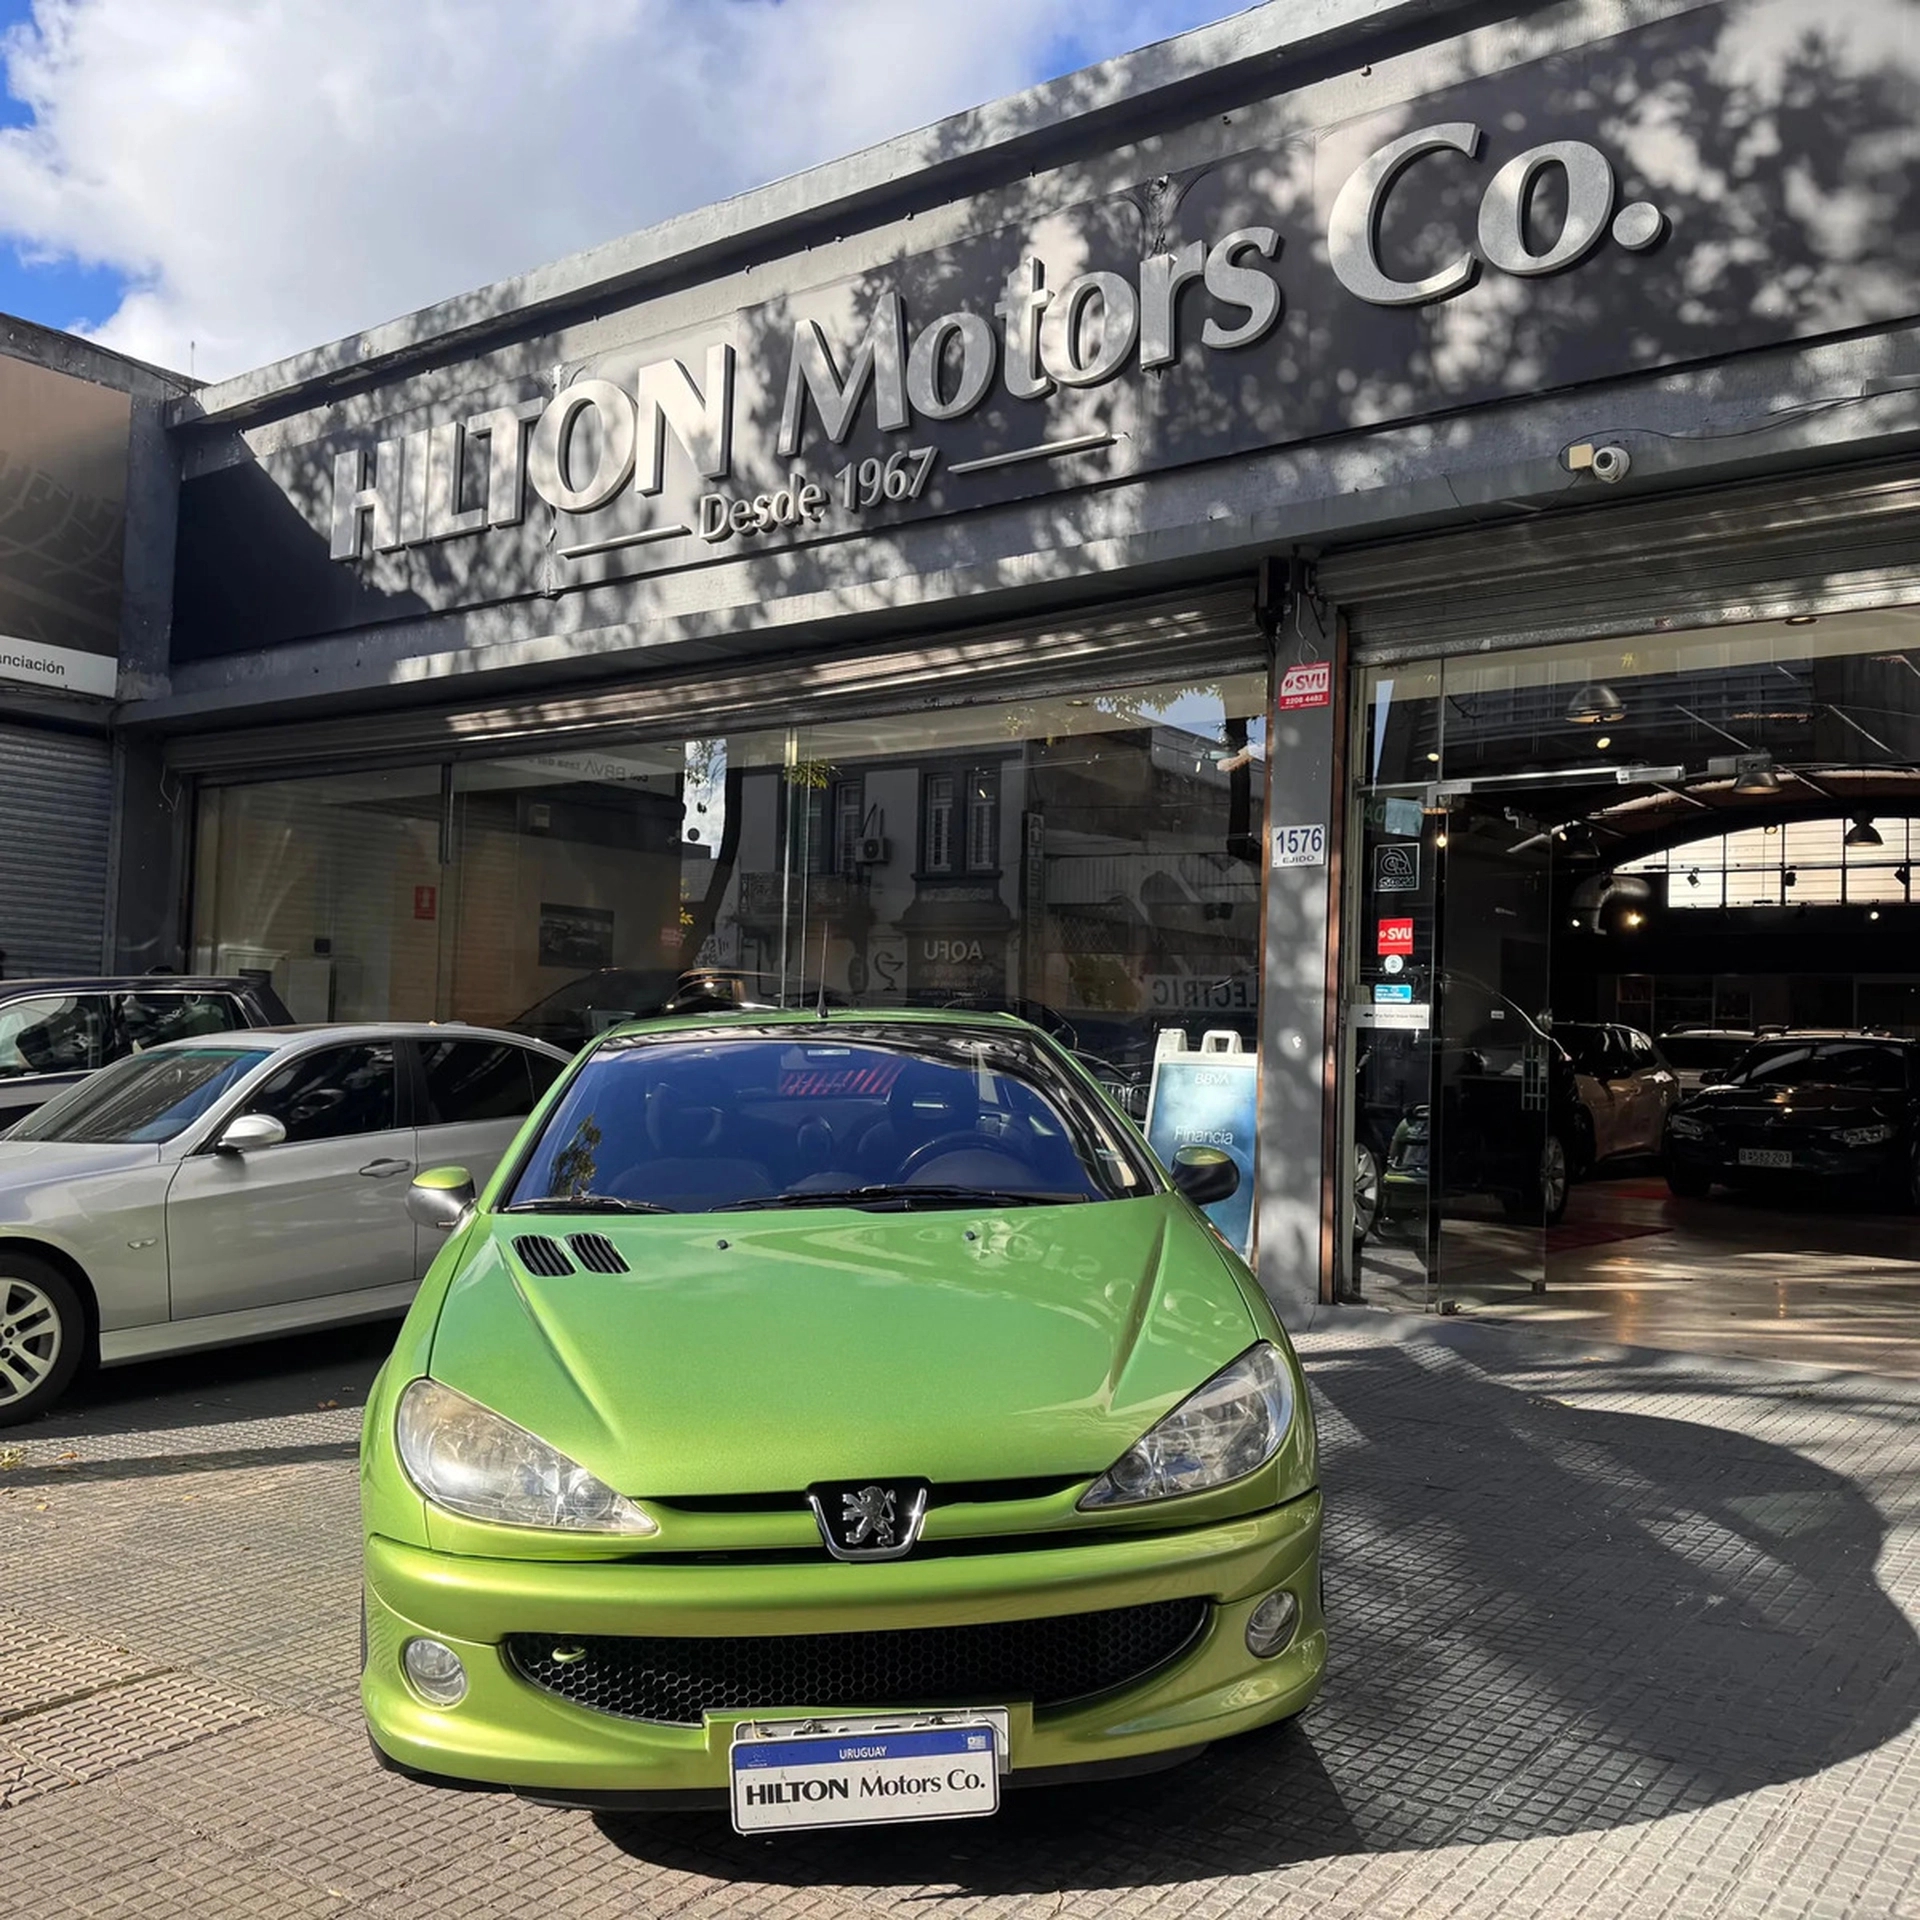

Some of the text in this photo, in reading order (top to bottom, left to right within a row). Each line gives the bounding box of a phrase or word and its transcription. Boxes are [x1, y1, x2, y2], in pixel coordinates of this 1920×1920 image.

[330, 122, 1664, 561] HILTON Motors Co.
[700, 446, 937, 543] Desde 1967
[1296, 672, 1326, 691] SVU
[1276, 826, 1323, 854] 1576
[1282, 855, 1315, 864] EJIDO
[1387, 928, 1412, 941] SVU
[1194, 1073, 1230, 1085] BBVA
[1174, 1125, 1234, 1145] Financia
[839, 1746, 888, 1760] URUGUAY
[746, 1769, 986, 1806] HILTON Motors Co.
